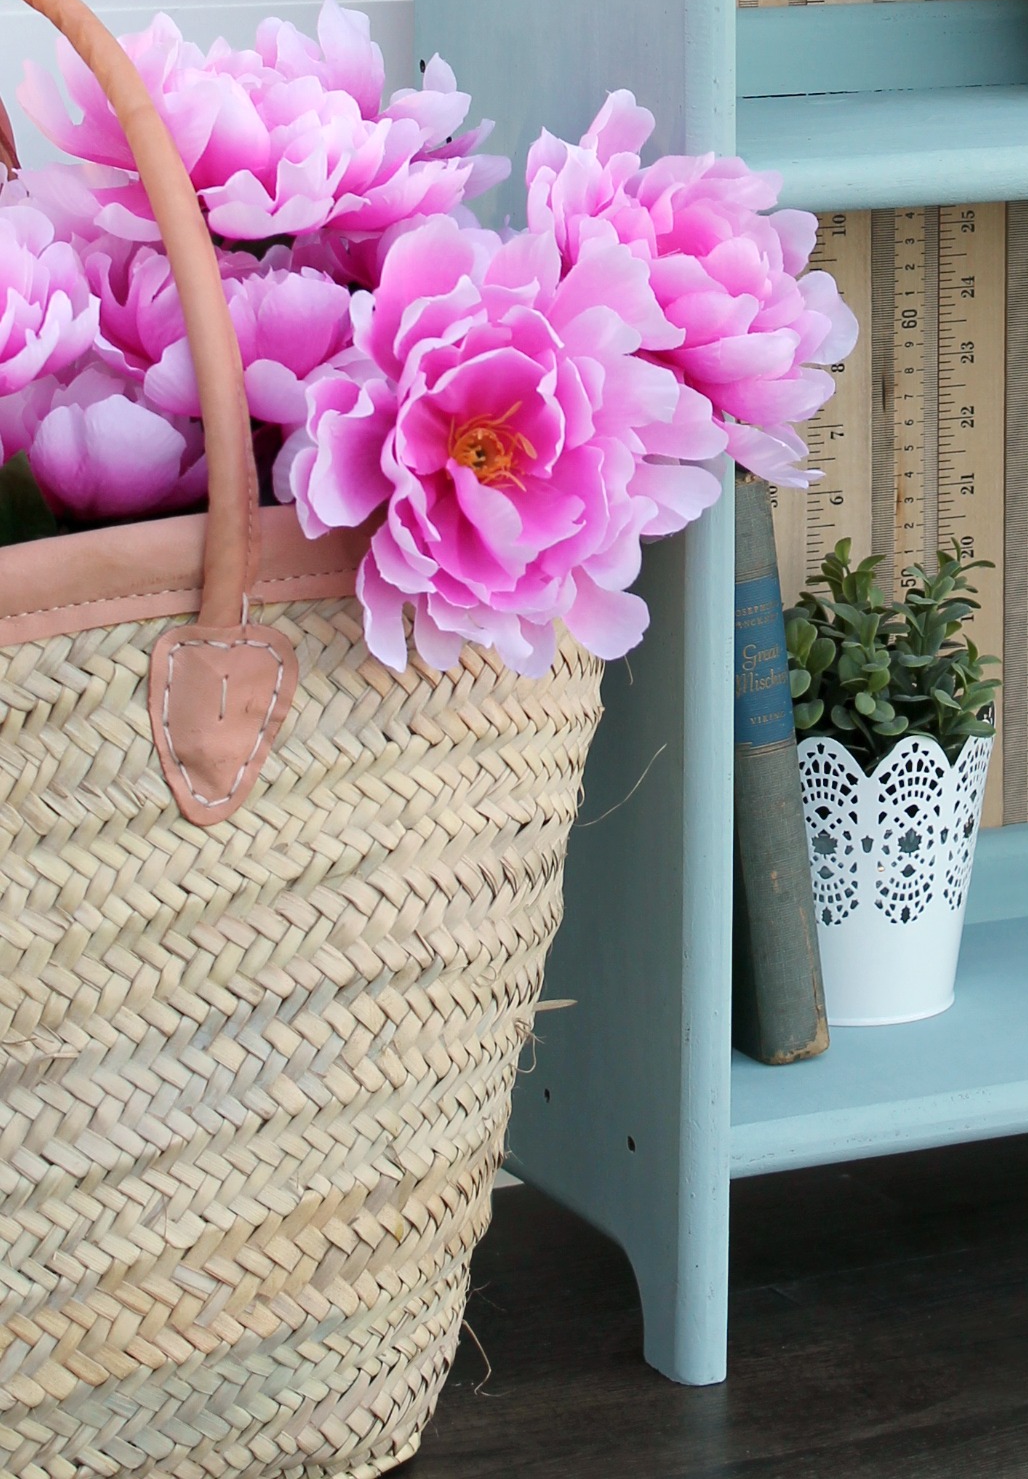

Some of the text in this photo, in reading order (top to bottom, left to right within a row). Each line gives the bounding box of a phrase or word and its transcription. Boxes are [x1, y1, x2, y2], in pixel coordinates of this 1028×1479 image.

[961, 210, 975, 233] 25
[961, 276, 975, 298] 24
[902, 309, 918, 330] 60
[830, 215, 846, 506] 6 7 8 10
[961, 341, 974, 364] 23
[961, 406, 974, 428] 22
[961, 473, 975, 495] 21
[961, 536, 974, 559] 20
